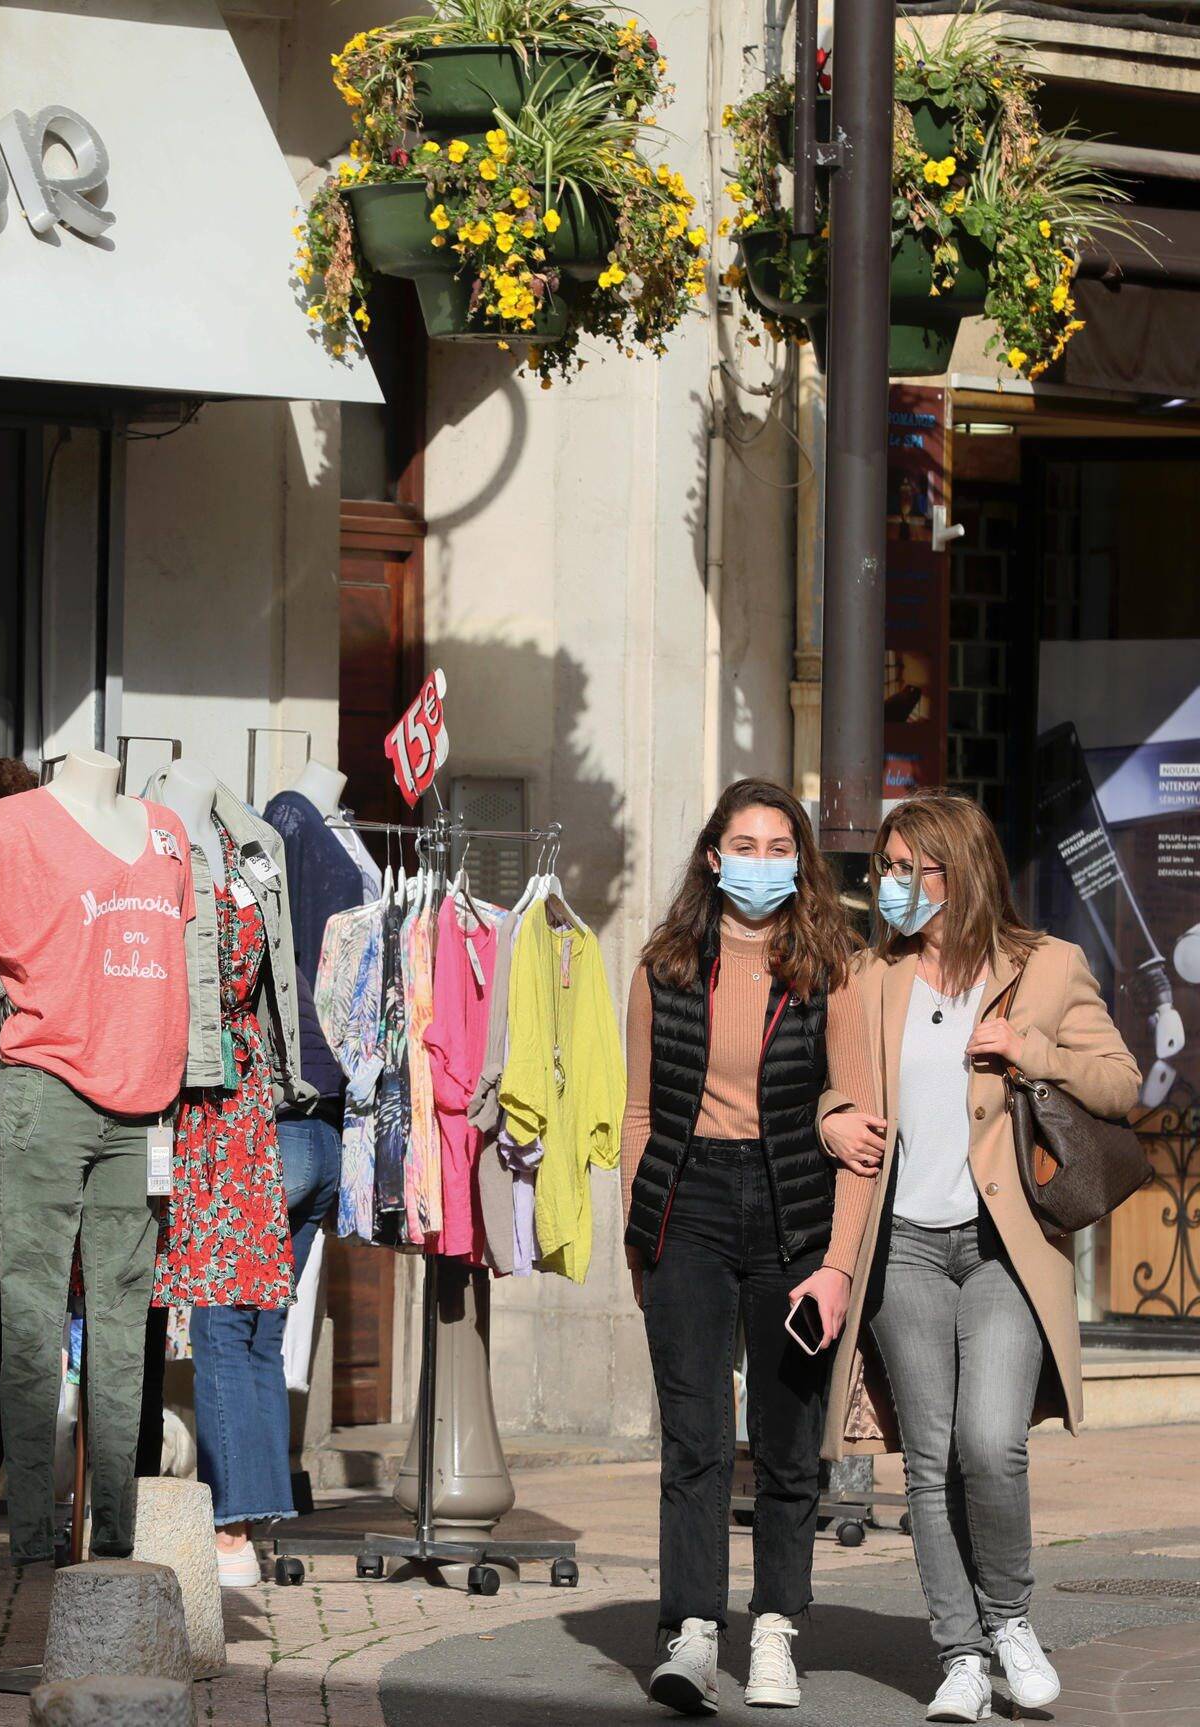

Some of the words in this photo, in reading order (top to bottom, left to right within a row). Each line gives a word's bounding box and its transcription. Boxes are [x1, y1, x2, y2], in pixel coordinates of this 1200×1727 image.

[391, 681, 439, 792] 15€
[123, 930, 149, 944] en
[104, 949, 168, 980] baskets
